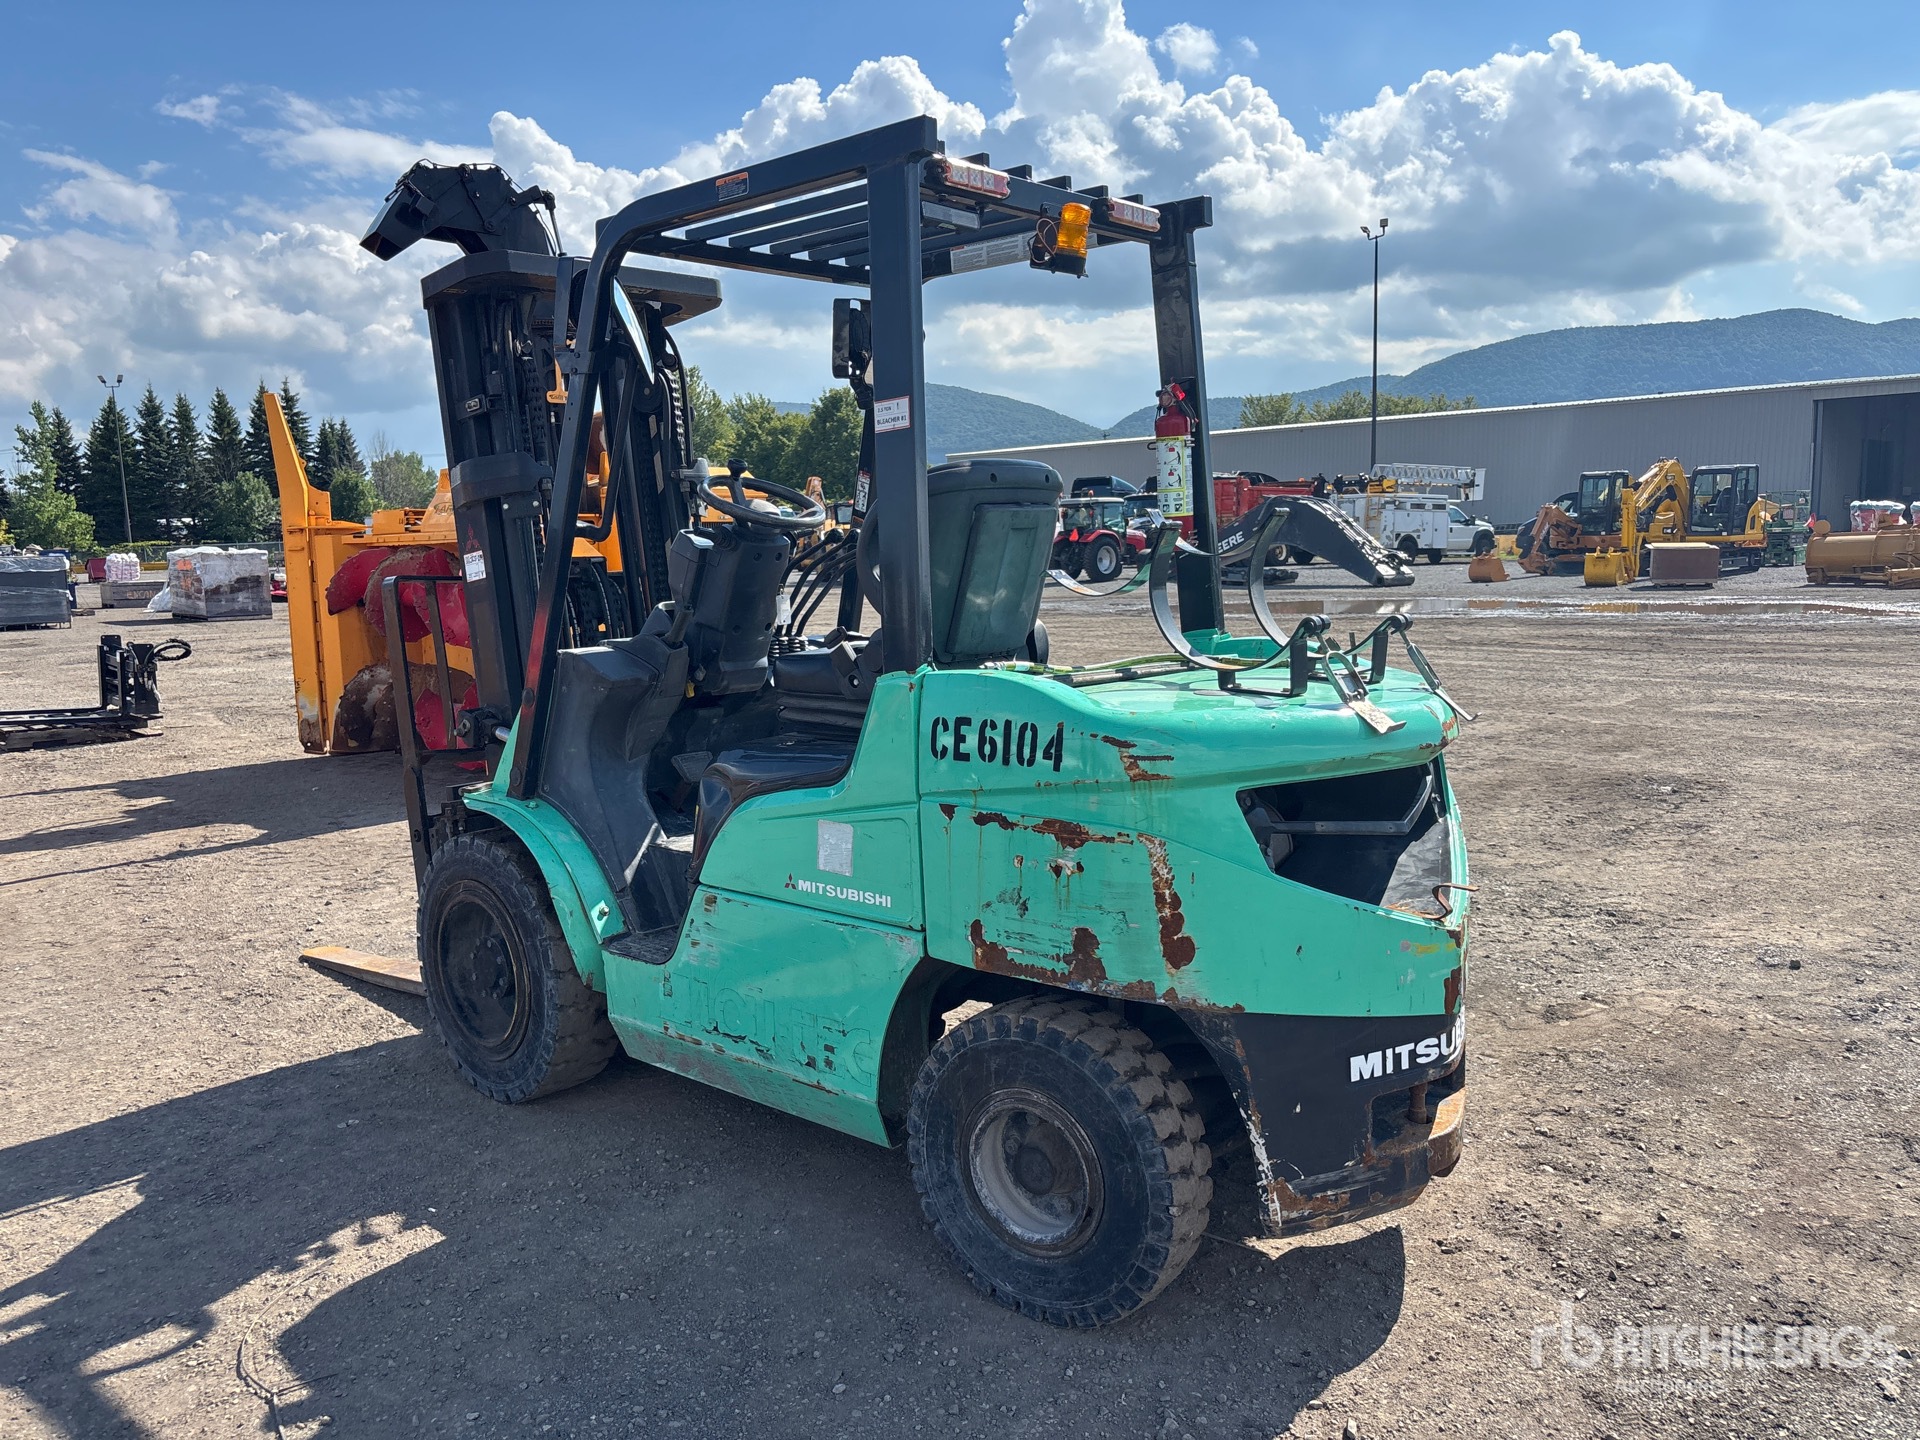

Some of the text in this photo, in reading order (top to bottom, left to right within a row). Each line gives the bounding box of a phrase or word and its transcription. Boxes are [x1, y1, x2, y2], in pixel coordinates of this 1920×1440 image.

[876, 415, 900, 426] BLEACHER
[930, 716, 1065, 772] CE6104
[798, 879, 892, 908] MITSUBISHI
